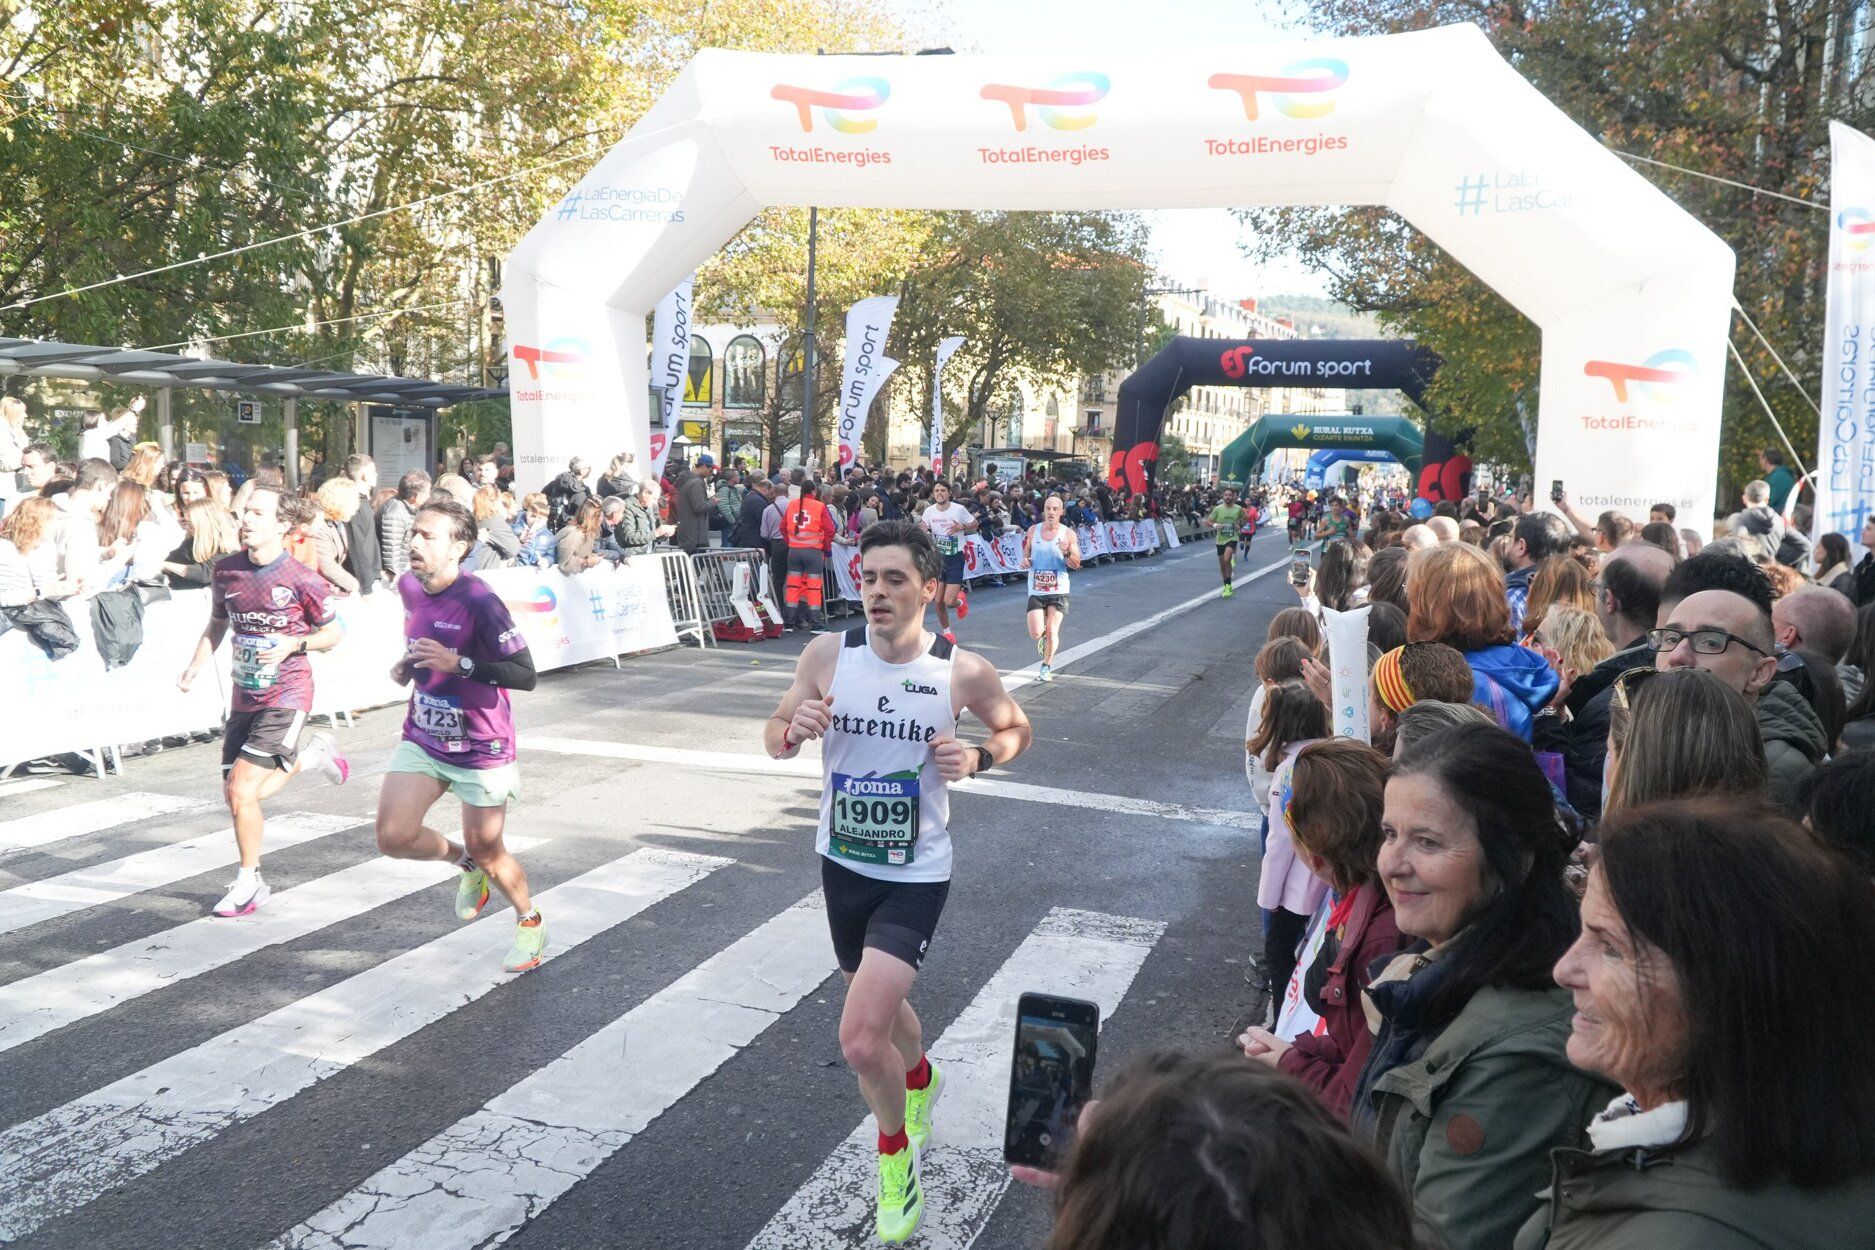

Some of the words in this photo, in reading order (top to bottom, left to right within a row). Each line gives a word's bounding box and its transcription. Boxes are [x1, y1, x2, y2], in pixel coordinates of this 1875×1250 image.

[1204, 133, 1348, 156] TotalEnergies
[769, 146, 892, 167] TotalEnergies
[978, 145, 1110, 165] TotalEnergies
[671, 292, 689, 350] sport
[855, 324, 879, 377] sport
[1316, 359, 1372, 378] sport
[1582, 415, 1698, 434] TotalEnerges
[1035, 575, 1056, 583] 4230
[228, 611, 288, 628] Huesca
[836, 797, 910, 826] 1909
[840, 824, 906, 839] ALEJANDRO
